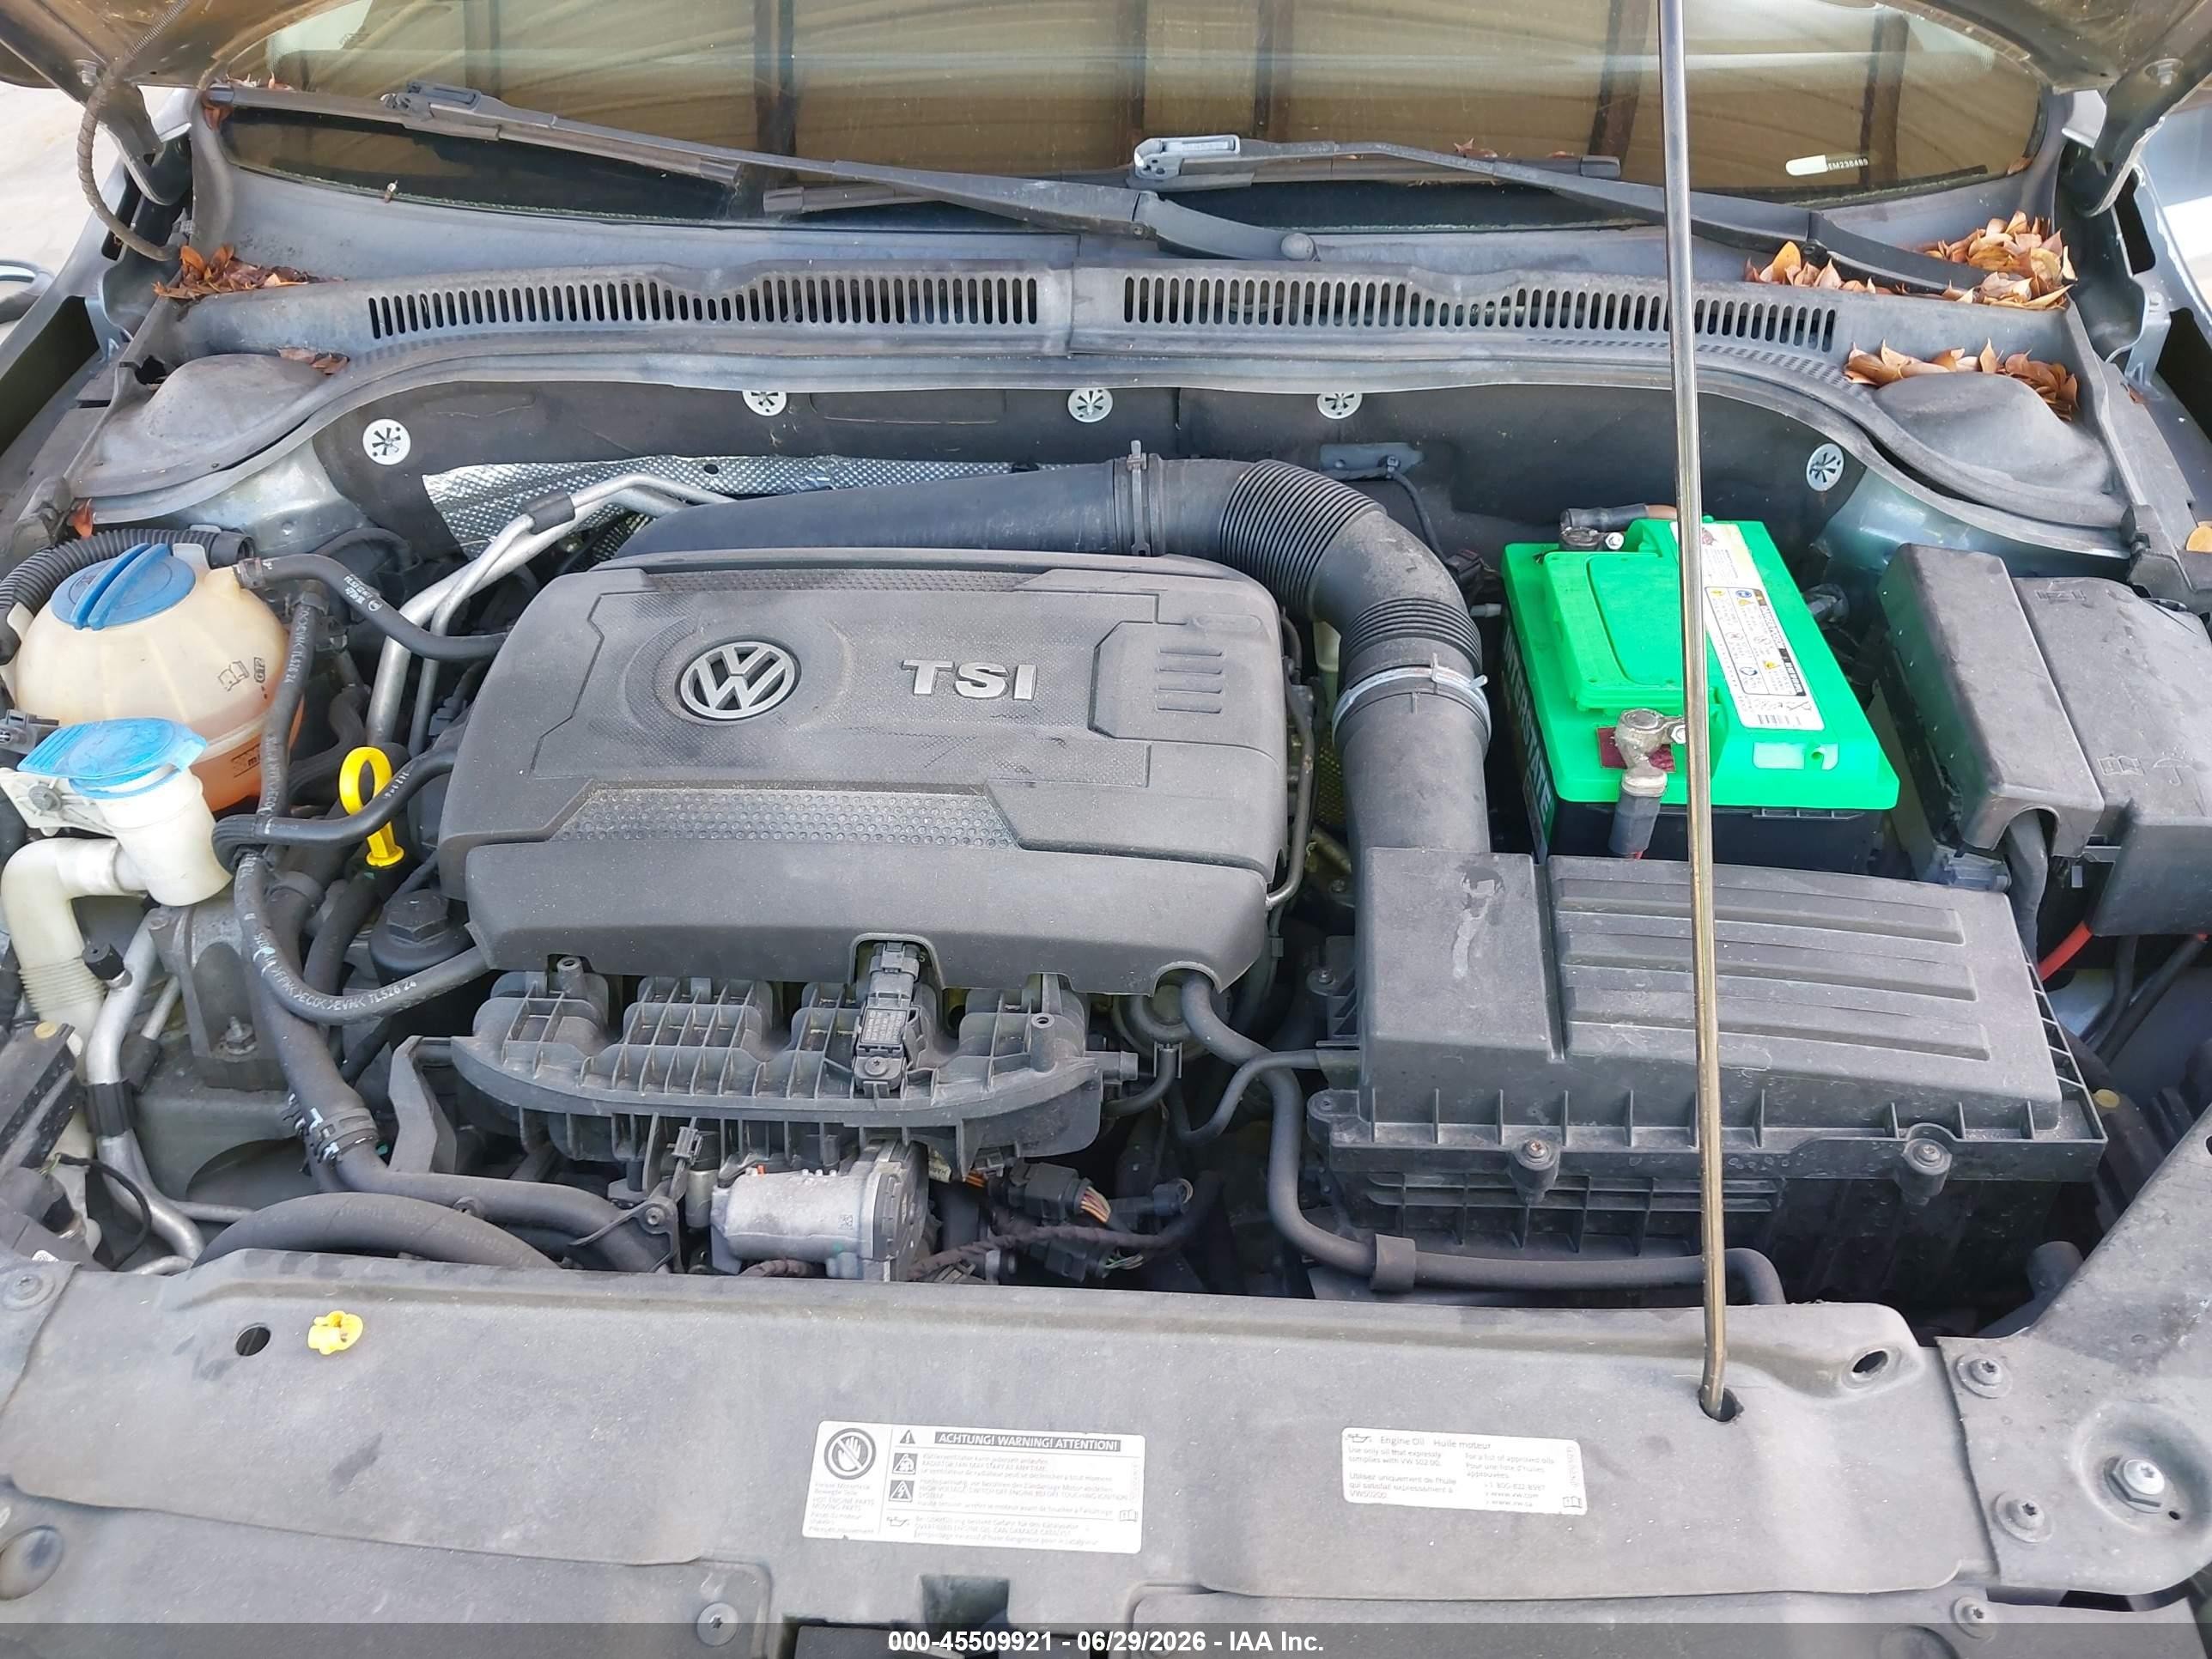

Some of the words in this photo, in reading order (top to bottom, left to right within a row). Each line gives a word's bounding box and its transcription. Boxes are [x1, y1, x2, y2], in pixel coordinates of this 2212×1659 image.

[683, 642, 793, 719] VW
[902, 659, 1037, 701] TSI
[1503, 624, 1553, 825] INTERSTATE
[938, 1432, 997, 1445] ACHTUNG!
[998, 1435, 1054, 1449] WARNING!
[1055, 1438, 1118, 1451] ATTENTION!
[1380, 1436, 1410, 1447] Engine
[1433, 1438, 1456, 1447] Huile
[1458, 1441, 1491, 1449] moteur
